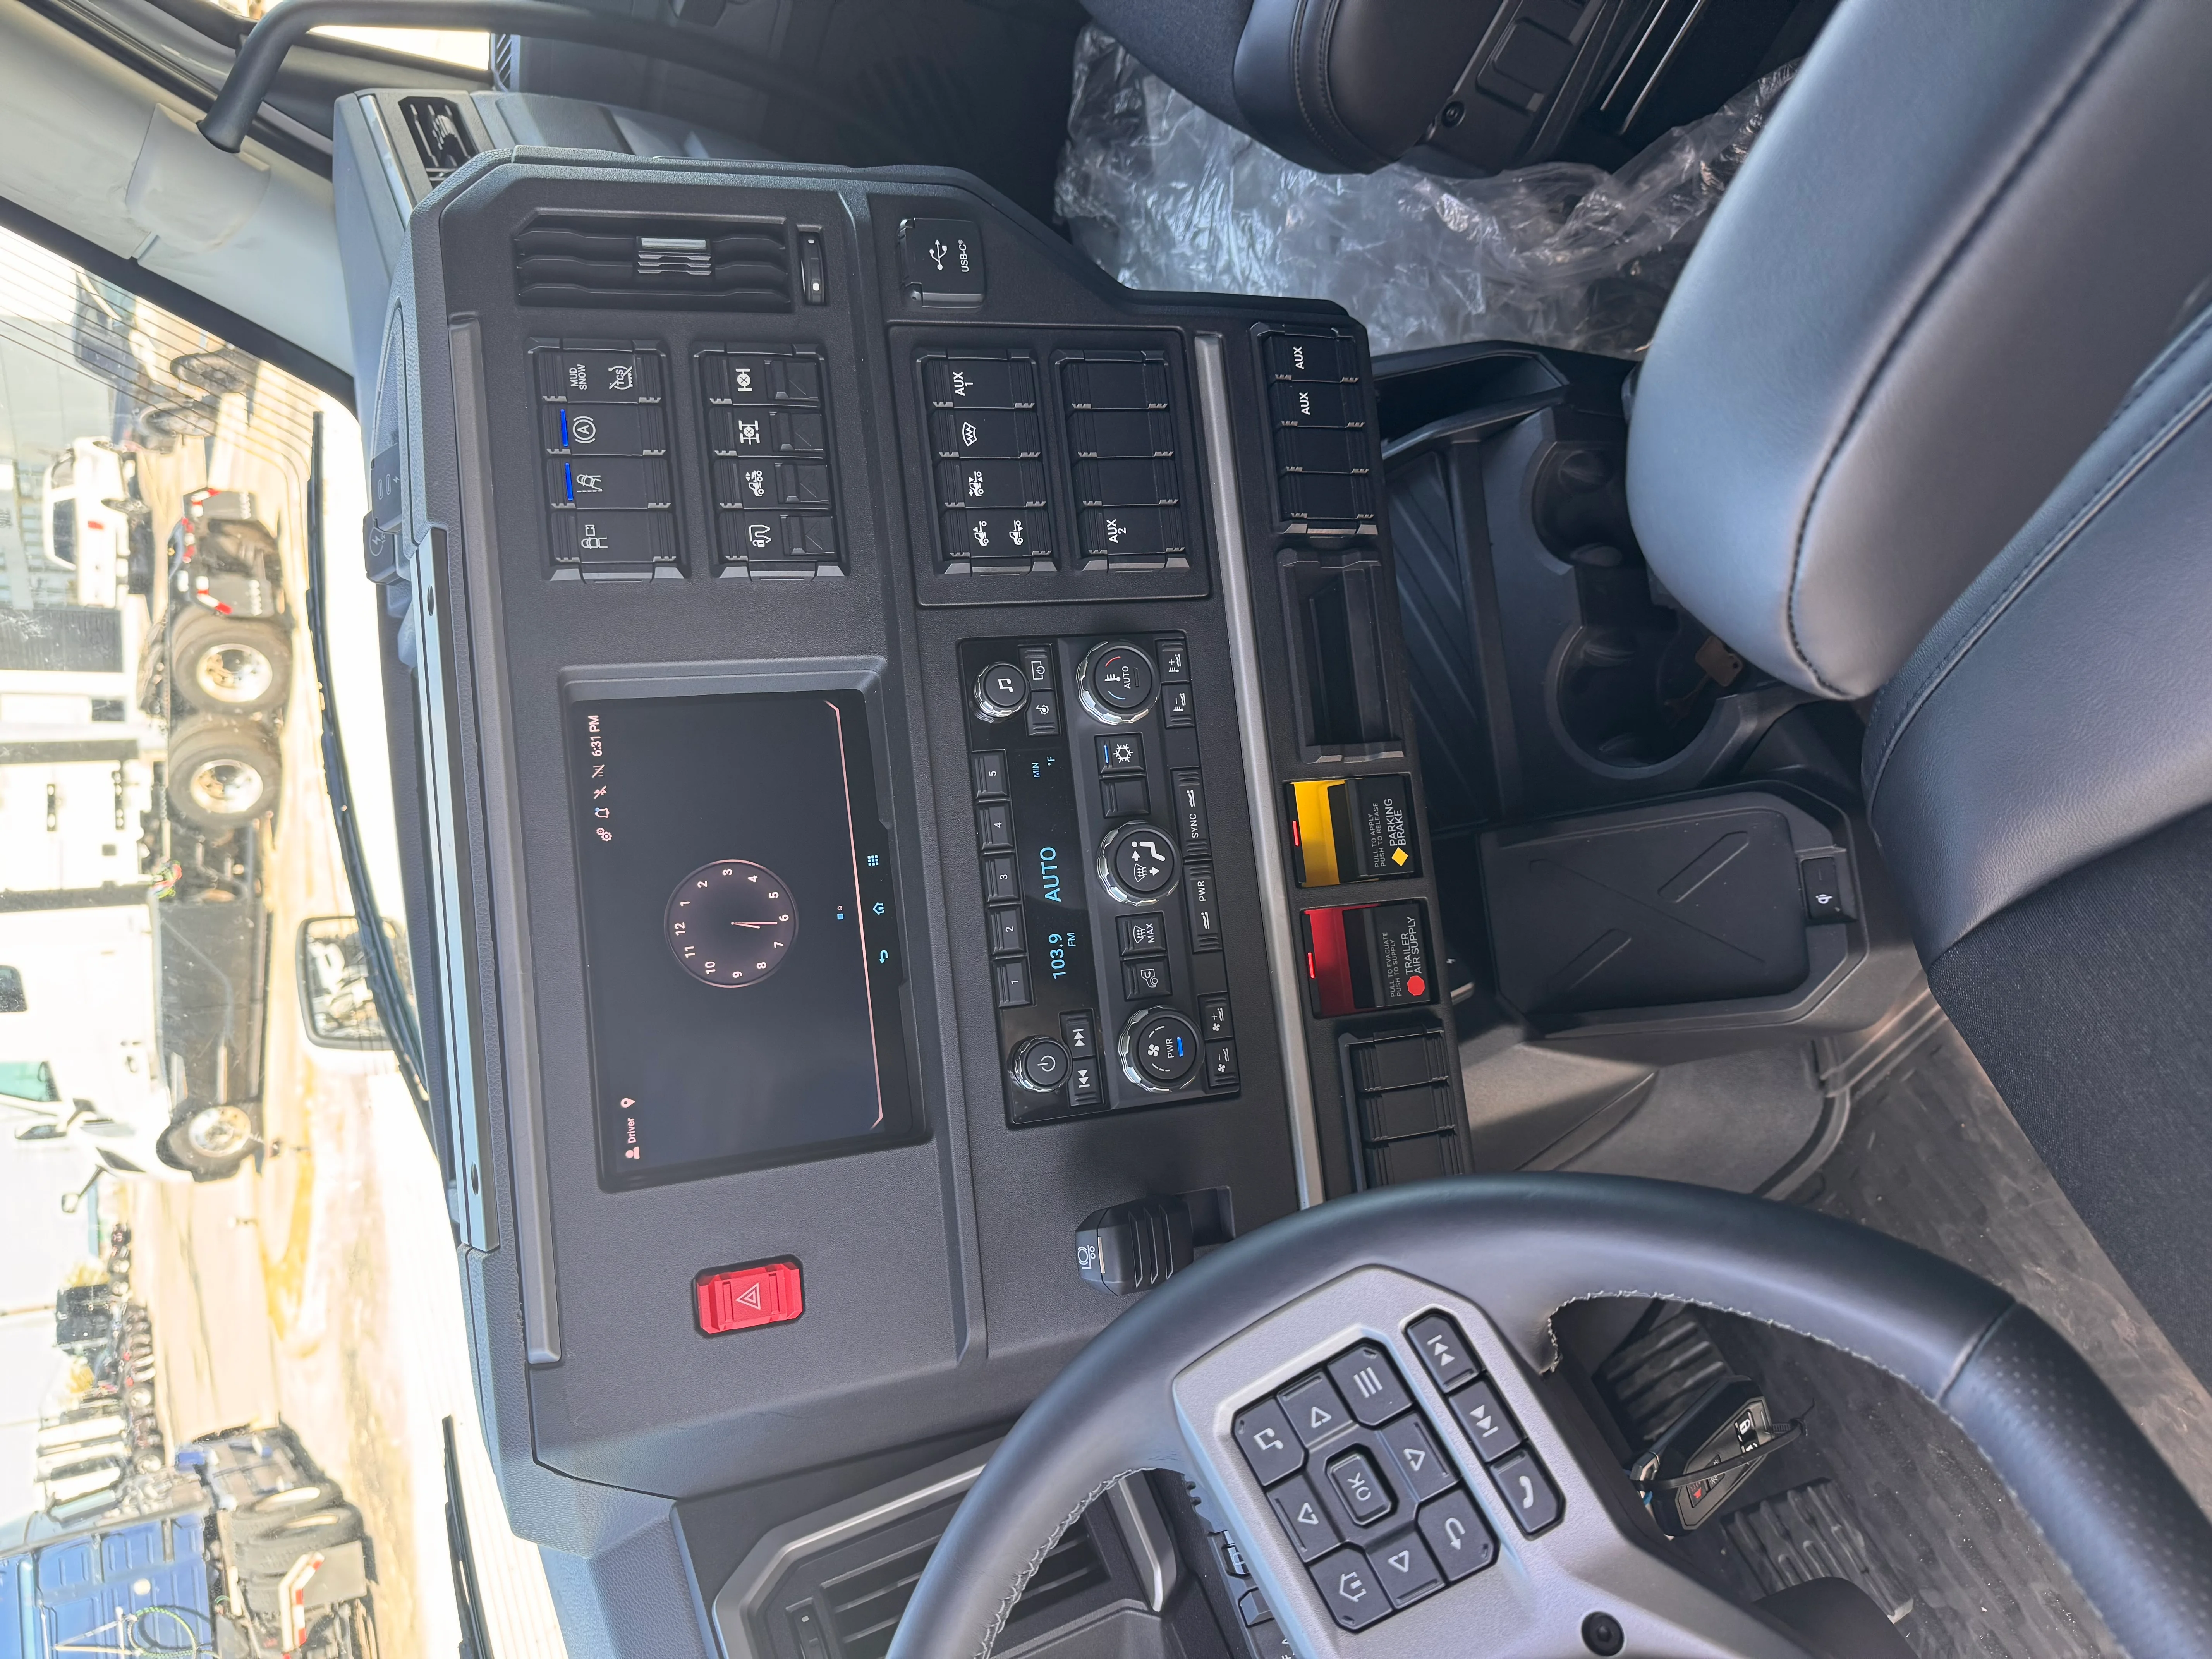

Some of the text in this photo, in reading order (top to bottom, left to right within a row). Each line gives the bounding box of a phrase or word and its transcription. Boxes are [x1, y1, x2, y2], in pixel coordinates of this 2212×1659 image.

[1293, 347, 1304, 369] AUX
[569, 368, 579, 387] MUD
[577, 364, 587, 390] SNOW
[953, 371, 965, 396] AUX
[1299, 392, 1310, 415] AUX
[578, 425, 590, 434] A
[1106, 519, 1119, 543] AUX
[1122, 666, 1131, 689] AUTO
[588, 715, 603, 757] 6:31 PM
[1032, 762, 1040, 778] MIN
[1190, 813, 1199, 838] SYNC
[1368, 814, 1376, 835] APPLY
[1373, 803, 1382, 833] RELEASE
[1384, 799, 1398, 846] PARKING
[1394, 809, 1406, 845] BRAKE
[1371, 838, 1377, 847] TO
[1377, 836, 1383, 845] TO
[1040, 847, 1061, 902] AUTO
[1198, 881, 1206, 902] PWR
[674, 922, 685, 936] 12
[1067, 932, 1076, 947] FM
[1146, 923, 1155, 943] MAX
[684, 946, 696, 958] 11
[1048, 934, 1066, 979] 103.9
[1382, 932, 1392, 967] EVACUATE
[1390, 939, 1398, 965] SUPPLY
[1401, 933, 1413, 975] TRAILER
[1407, 917, 1422, 974] AIR SUPPLY
[705, 961, 716, 975] 10
[1388, 969, 1393, 979] TO
[1394, 967, 1399, 976] TO
[1166, 1038, 1175, 1058] PWR
[627, 1118, 636, 1144] Driver
[1347, 1472, 1371, 1501] OK
